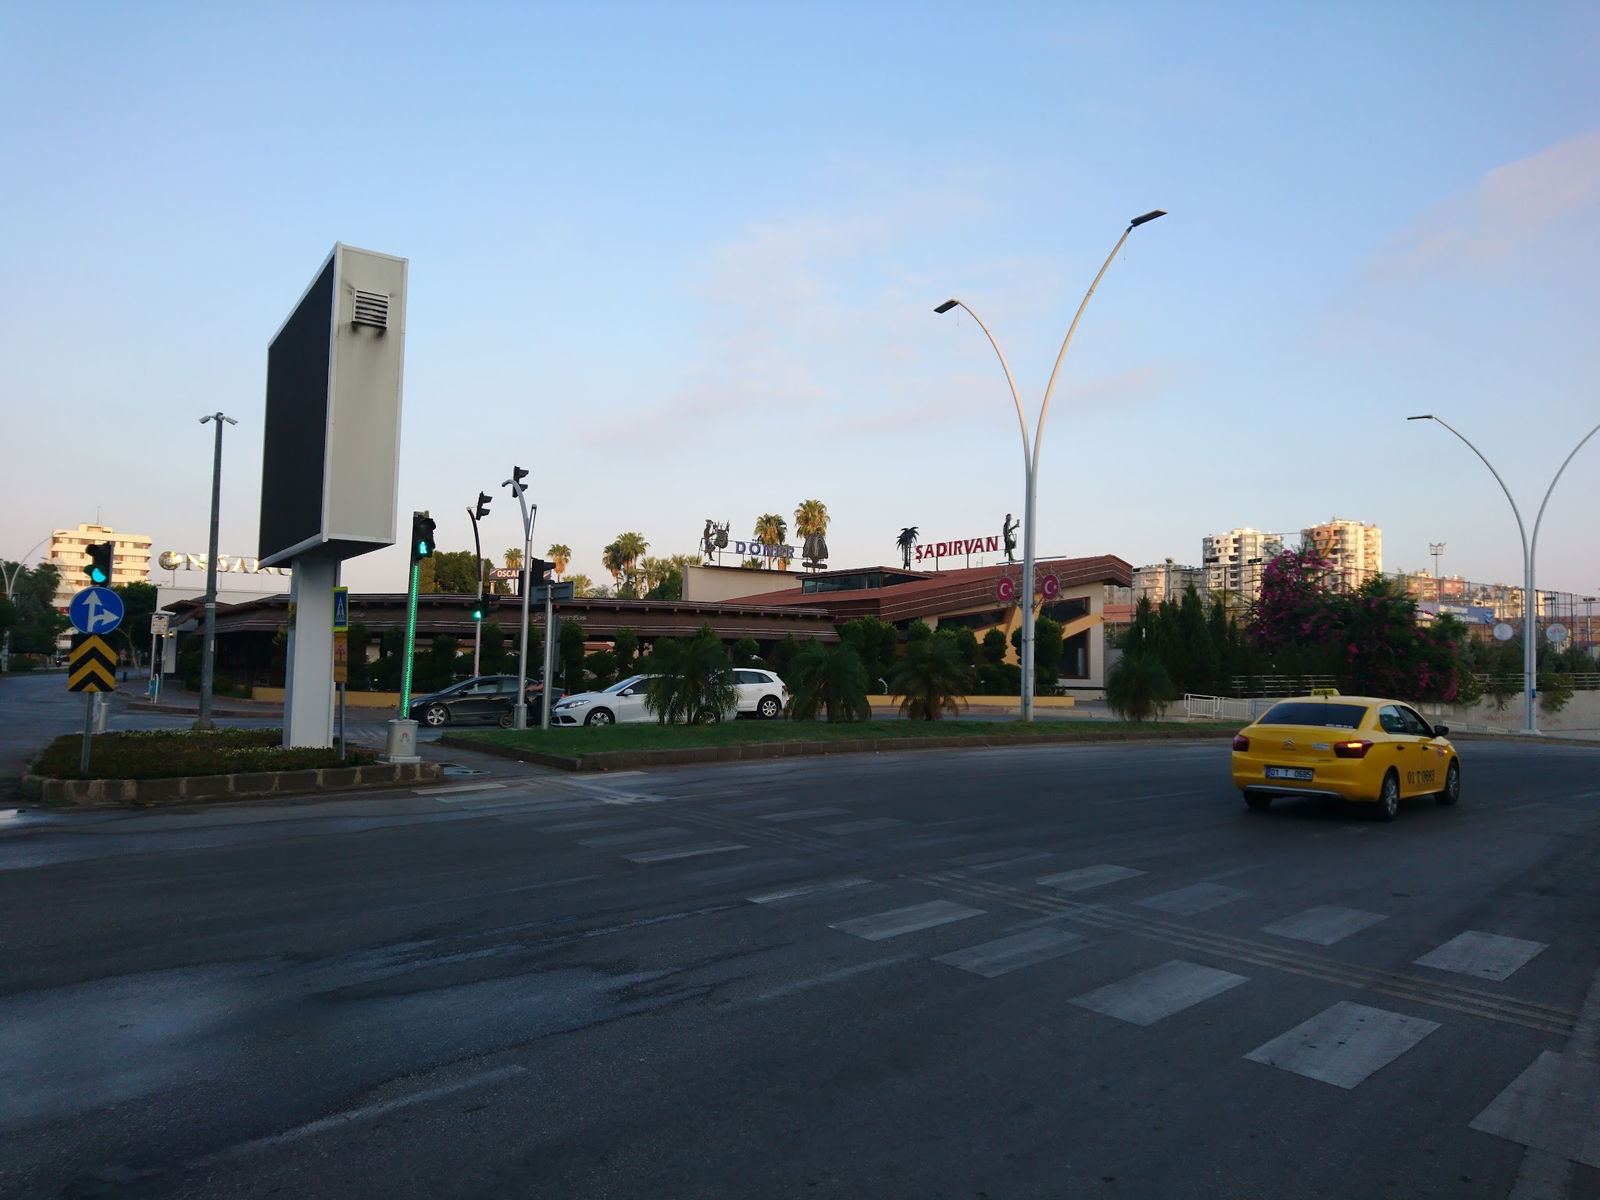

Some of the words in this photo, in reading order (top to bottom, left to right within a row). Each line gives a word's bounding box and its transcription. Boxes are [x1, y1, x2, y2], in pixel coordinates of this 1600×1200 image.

[735, 538, 795, 558] DÖNER
[915, 536, 998, 563] ŞADIRVAN
[1271, 768, 1279, 776] 01
